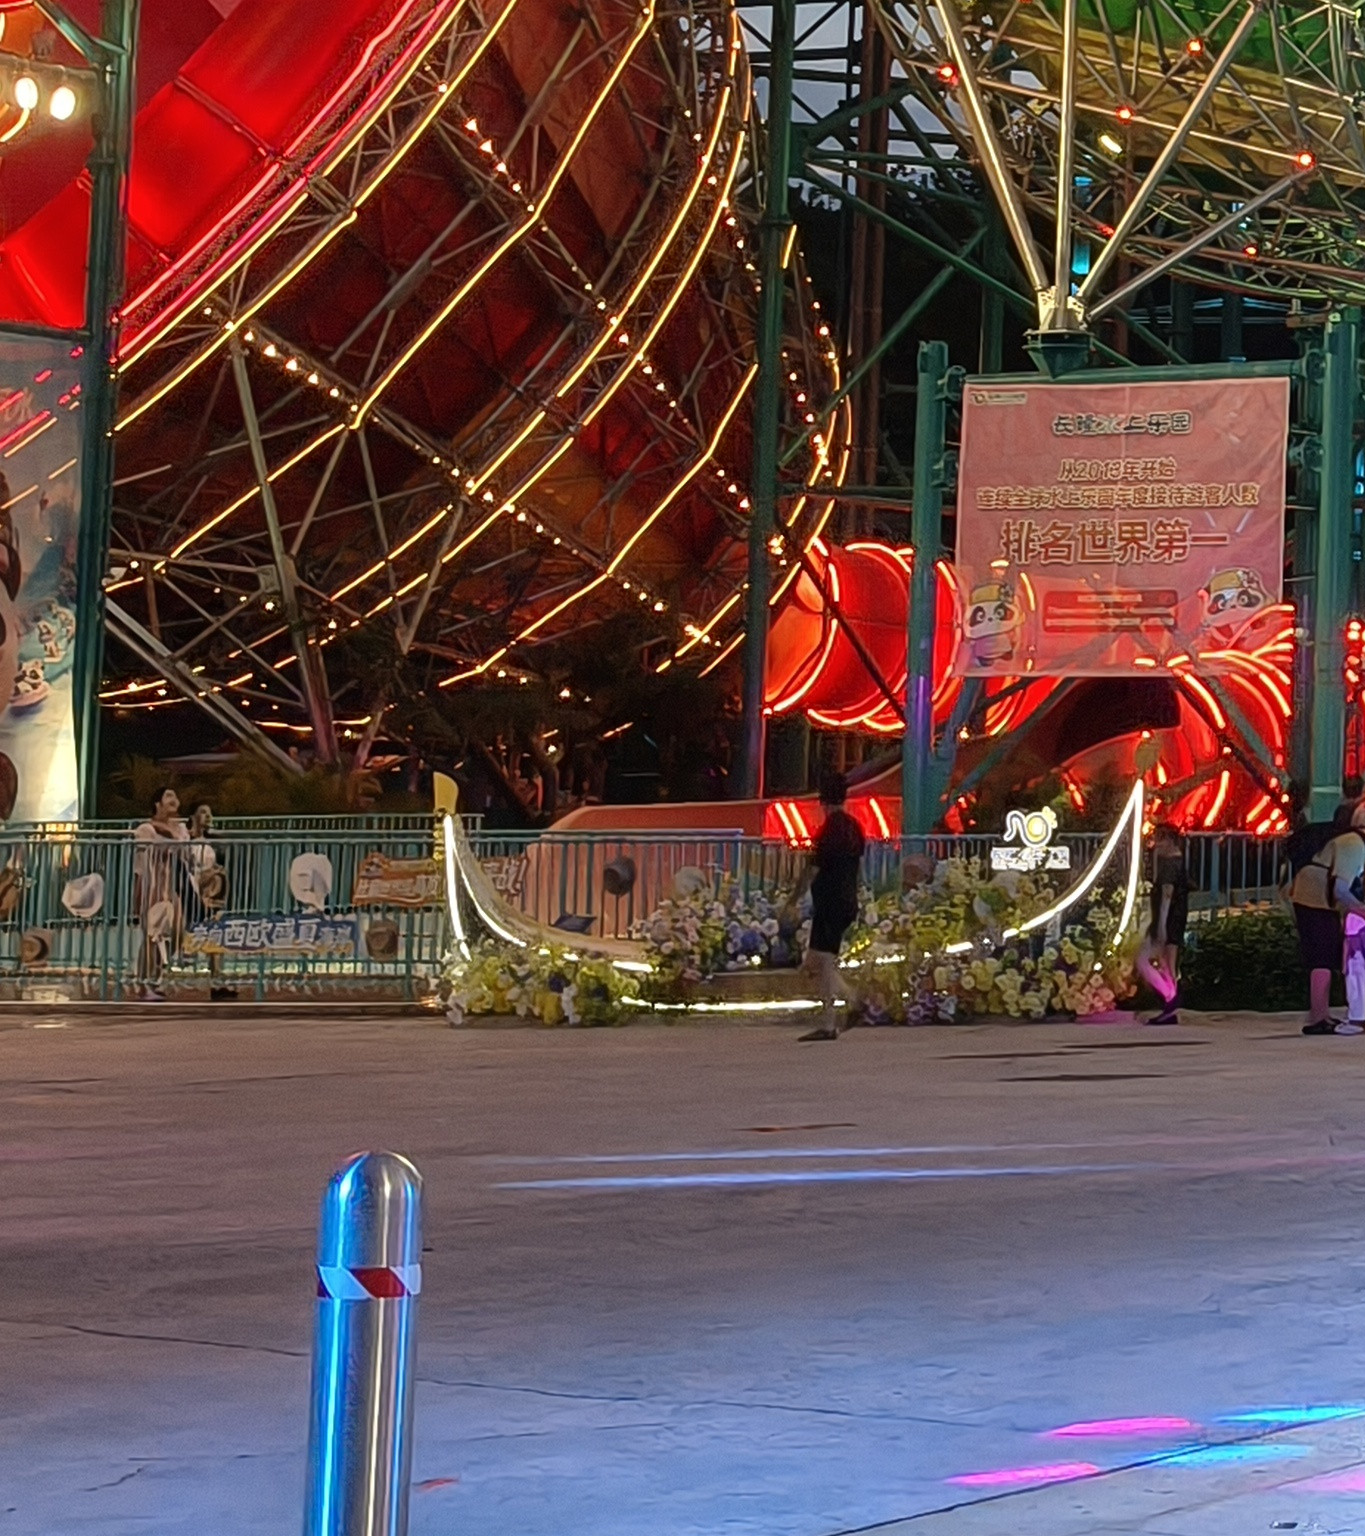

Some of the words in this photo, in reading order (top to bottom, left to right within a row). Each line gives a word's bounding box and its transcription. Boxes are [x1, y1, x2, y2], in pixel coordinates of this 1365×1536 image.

[1053, 413, 1192, 435] 长隆水上乐园
[1001, 519, 1228, 563] 排名世界第一
